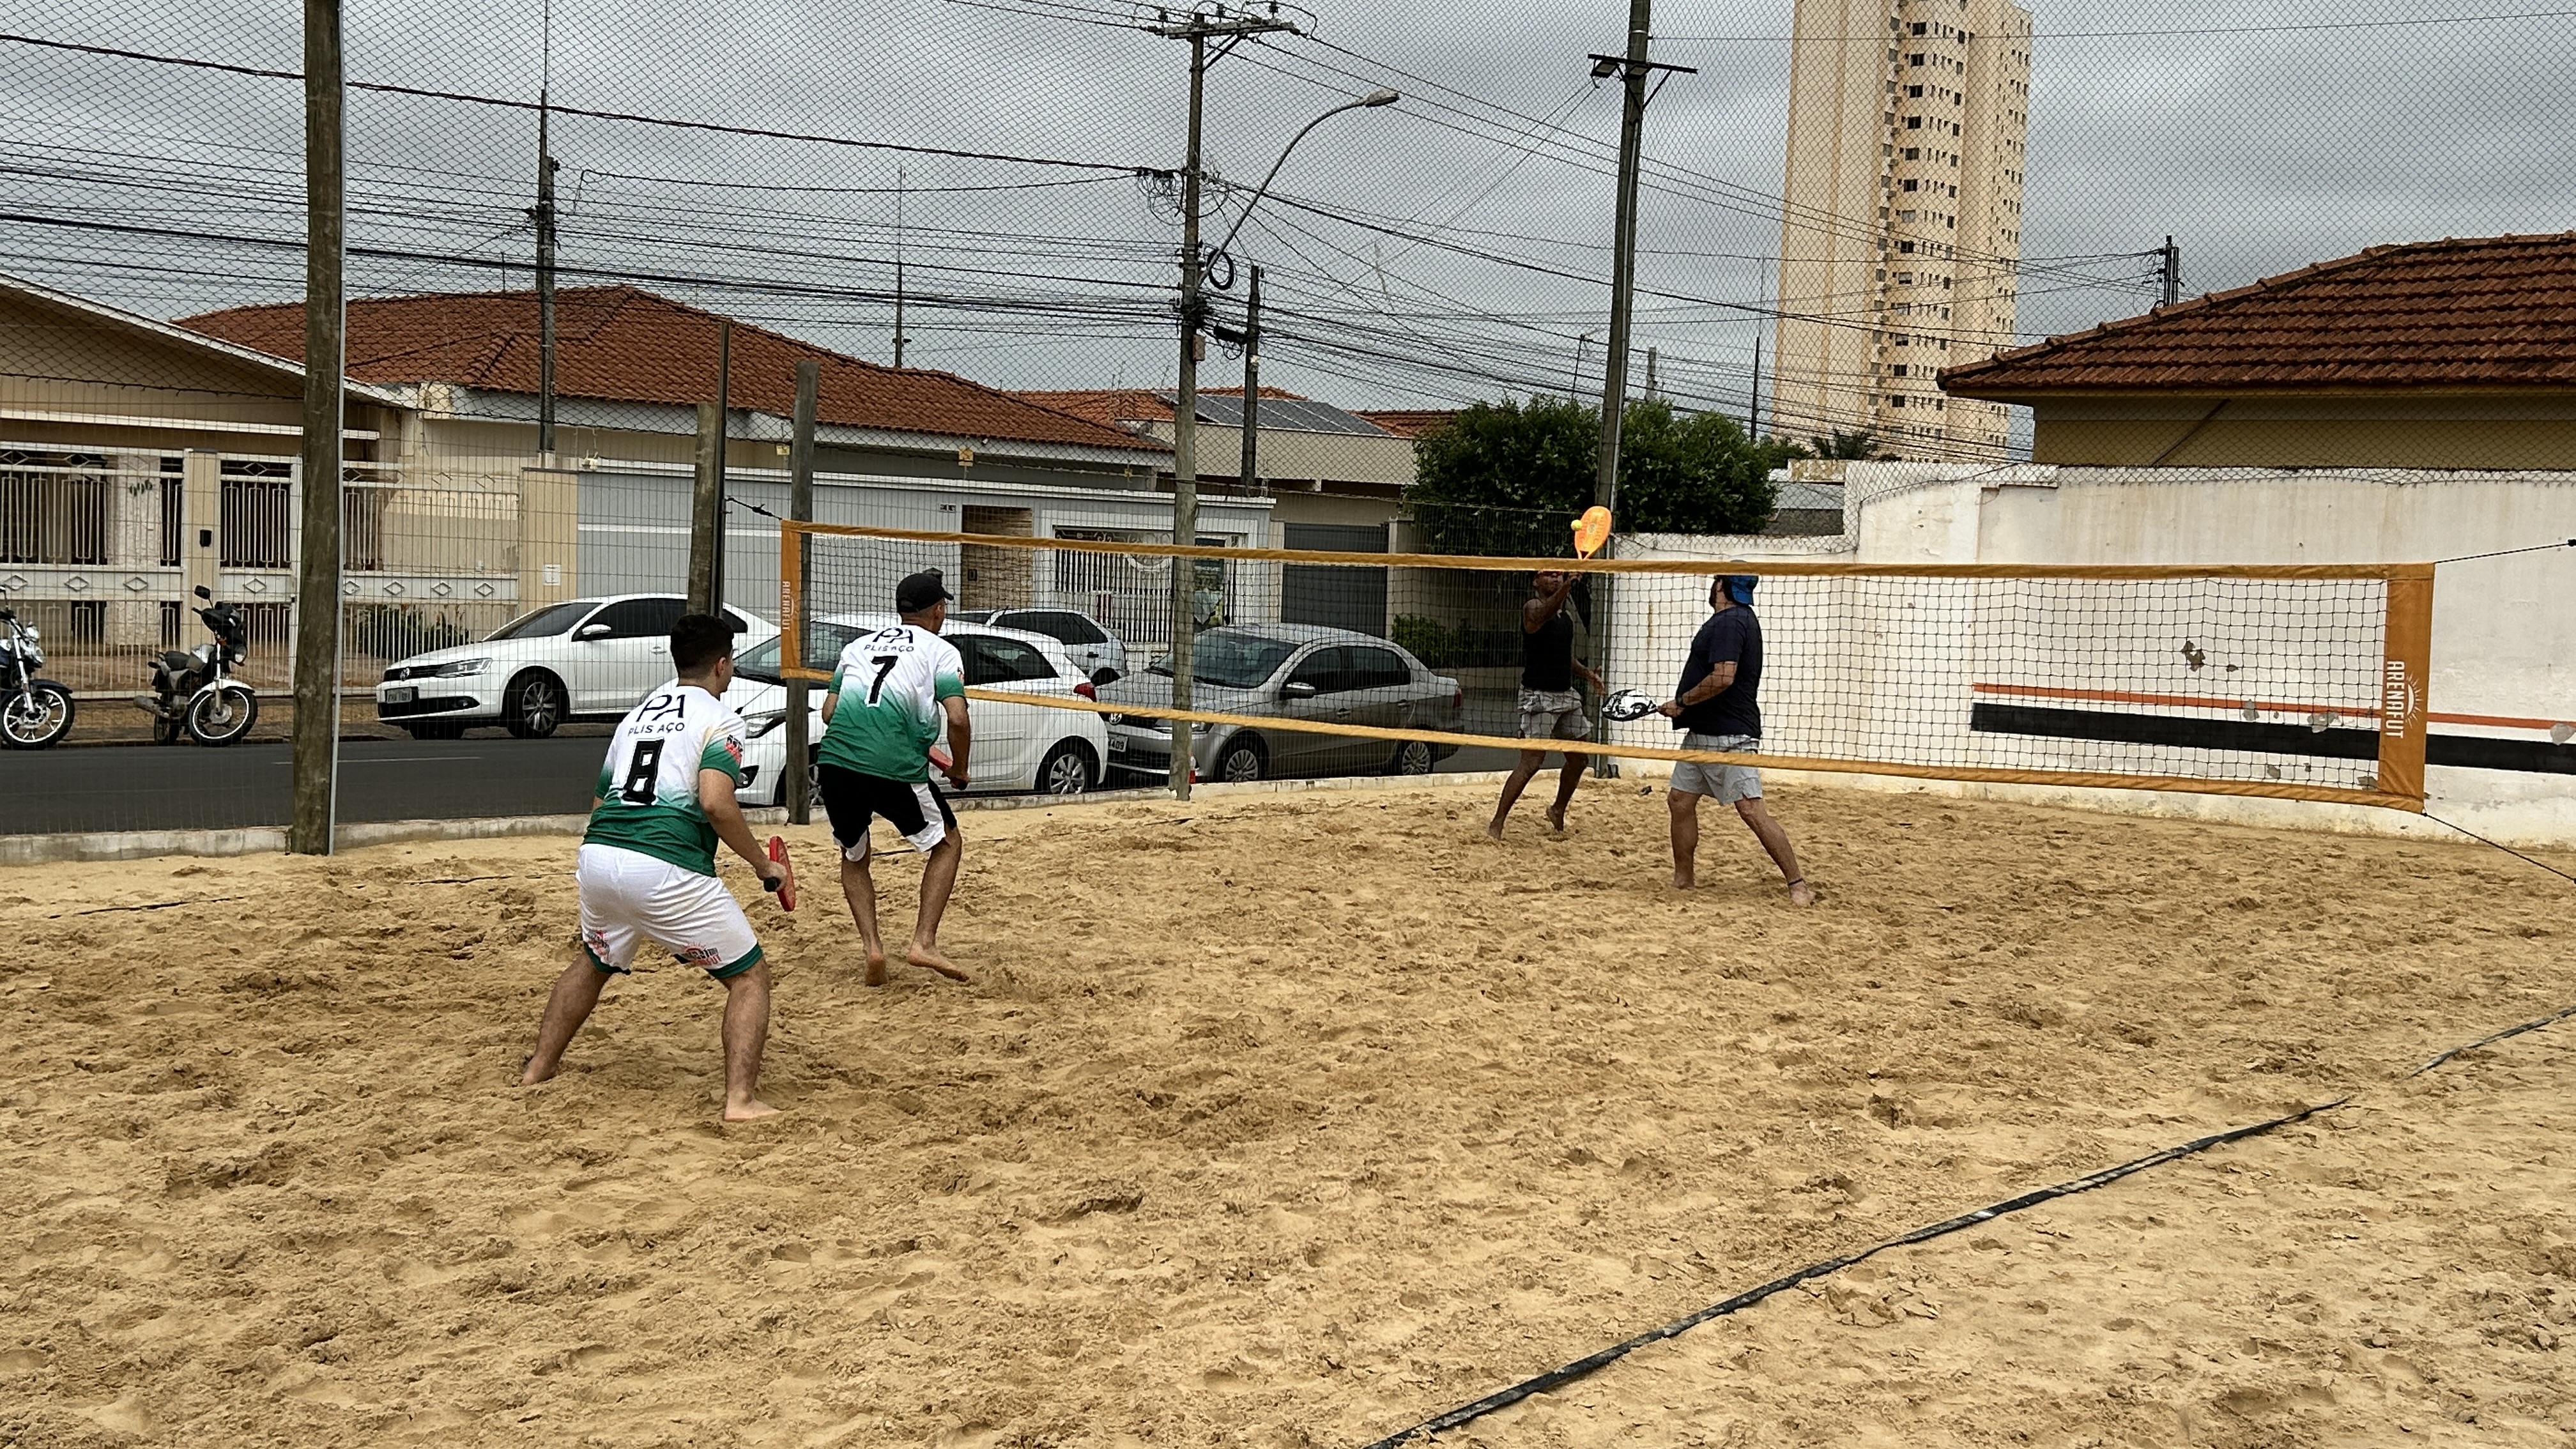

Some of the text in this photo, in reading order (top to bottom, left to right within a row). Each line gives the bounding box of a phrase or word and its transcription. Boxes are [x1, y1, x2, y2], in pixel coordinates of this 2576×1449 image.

[782, 581, 791, 631] ARENAFUT
[868, 655, 899, 705] 7
[2385, 661, 2405, 739] ARENAFUT
[621, 738, 665, 805] 8
